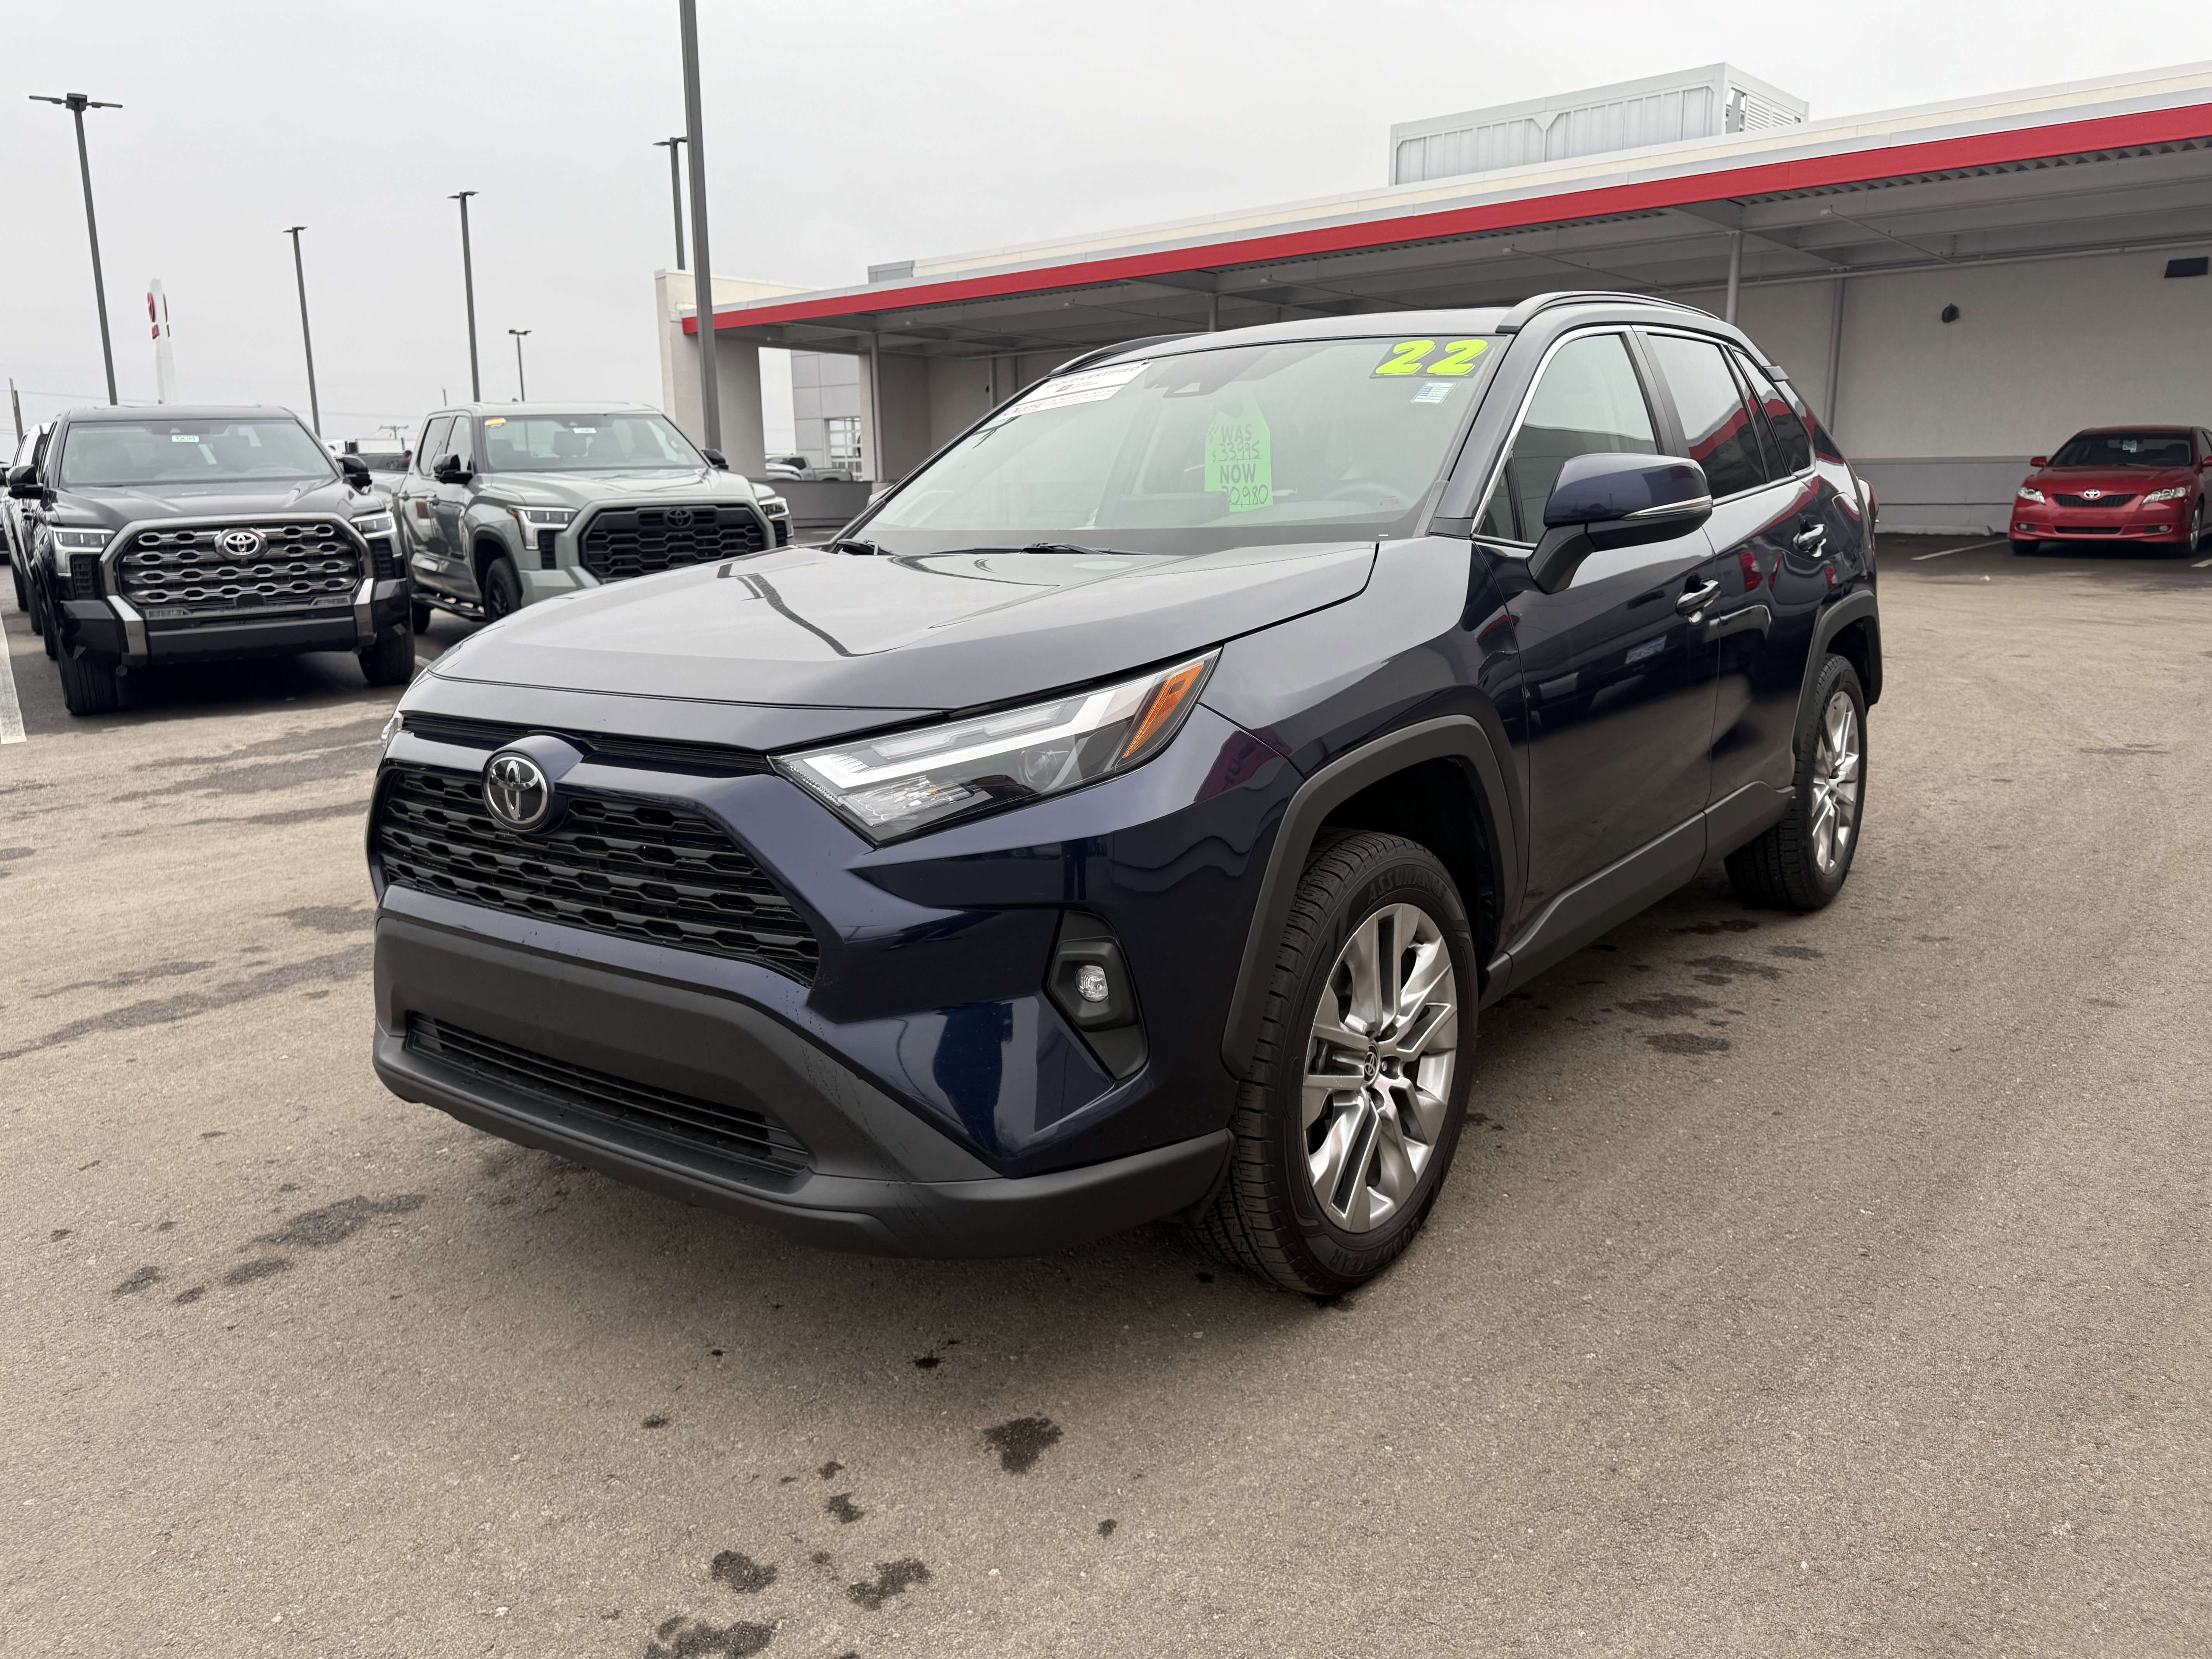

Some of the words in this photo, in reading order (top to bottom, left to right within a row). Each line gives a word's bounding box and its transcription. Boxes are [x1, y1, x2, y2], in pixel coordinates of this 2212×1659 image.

[1376, 339, 1489, 376] 22
[1080, 366, 1140, 381] CERTIFIED
[1221, 423, 1252, 443] WAS
[1220, 464, 1256, 484] NOW
[1368, 867, 1447, 905] ASSURANCE
